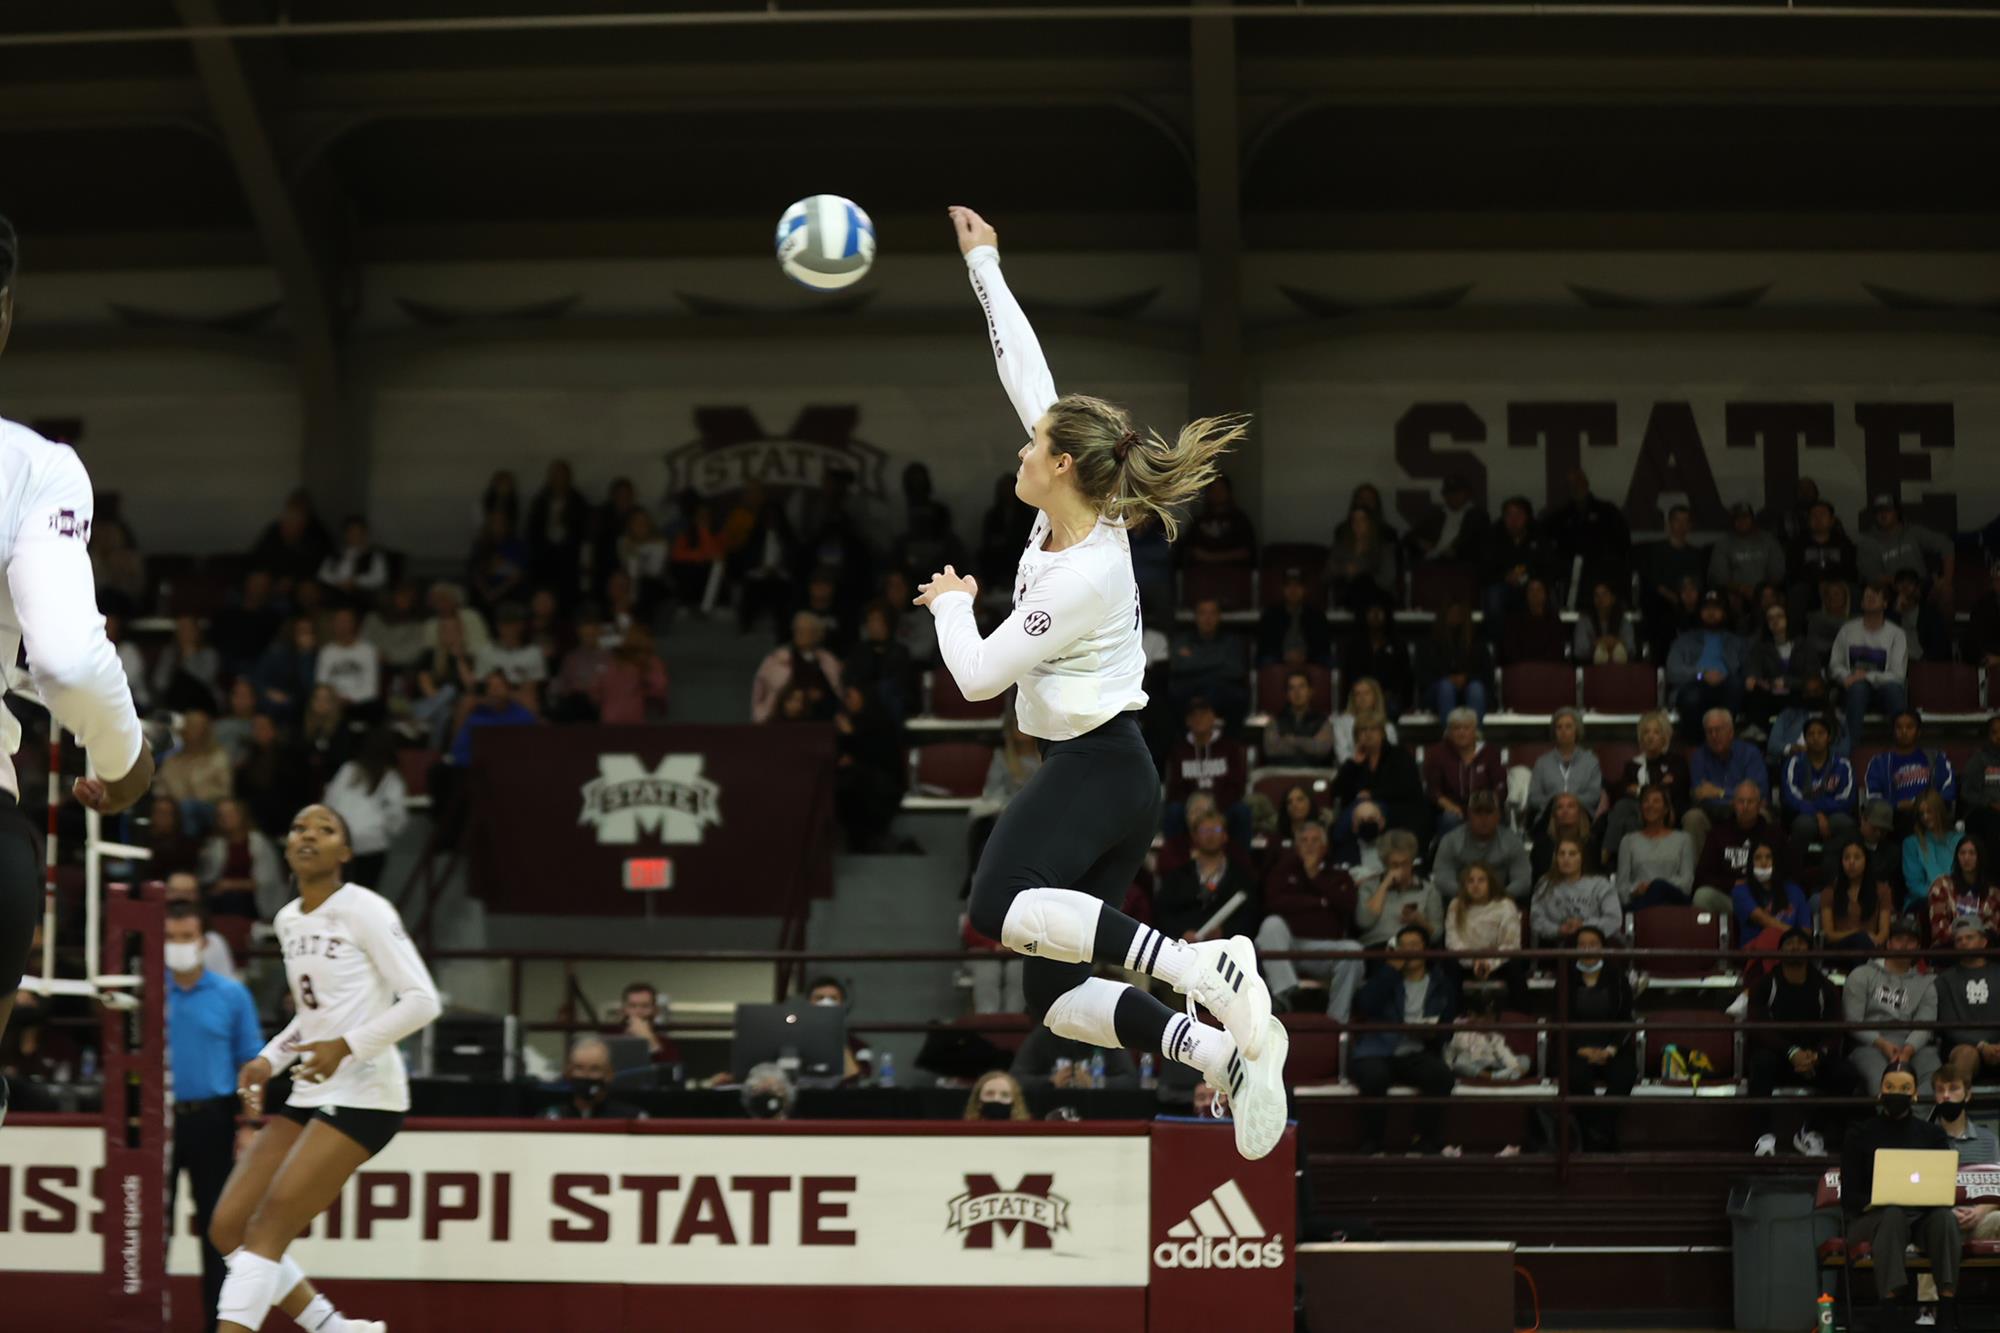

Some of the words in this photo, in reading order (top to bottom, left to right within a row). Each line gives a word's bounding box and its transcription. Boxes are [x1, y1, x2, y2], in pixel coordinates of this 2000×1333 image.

[1395, 401, 1957, 533] STATE
[300, 974, 319, 1010] 8
[121, 1175, 142, 1228] sports
[550, 1172, 858, 1246] STATE
[967, 1197, 1048, 1221] STATE
[121, 1229, 142, 1295] imports
[1153, 1236, 1284, 1269] adidas
